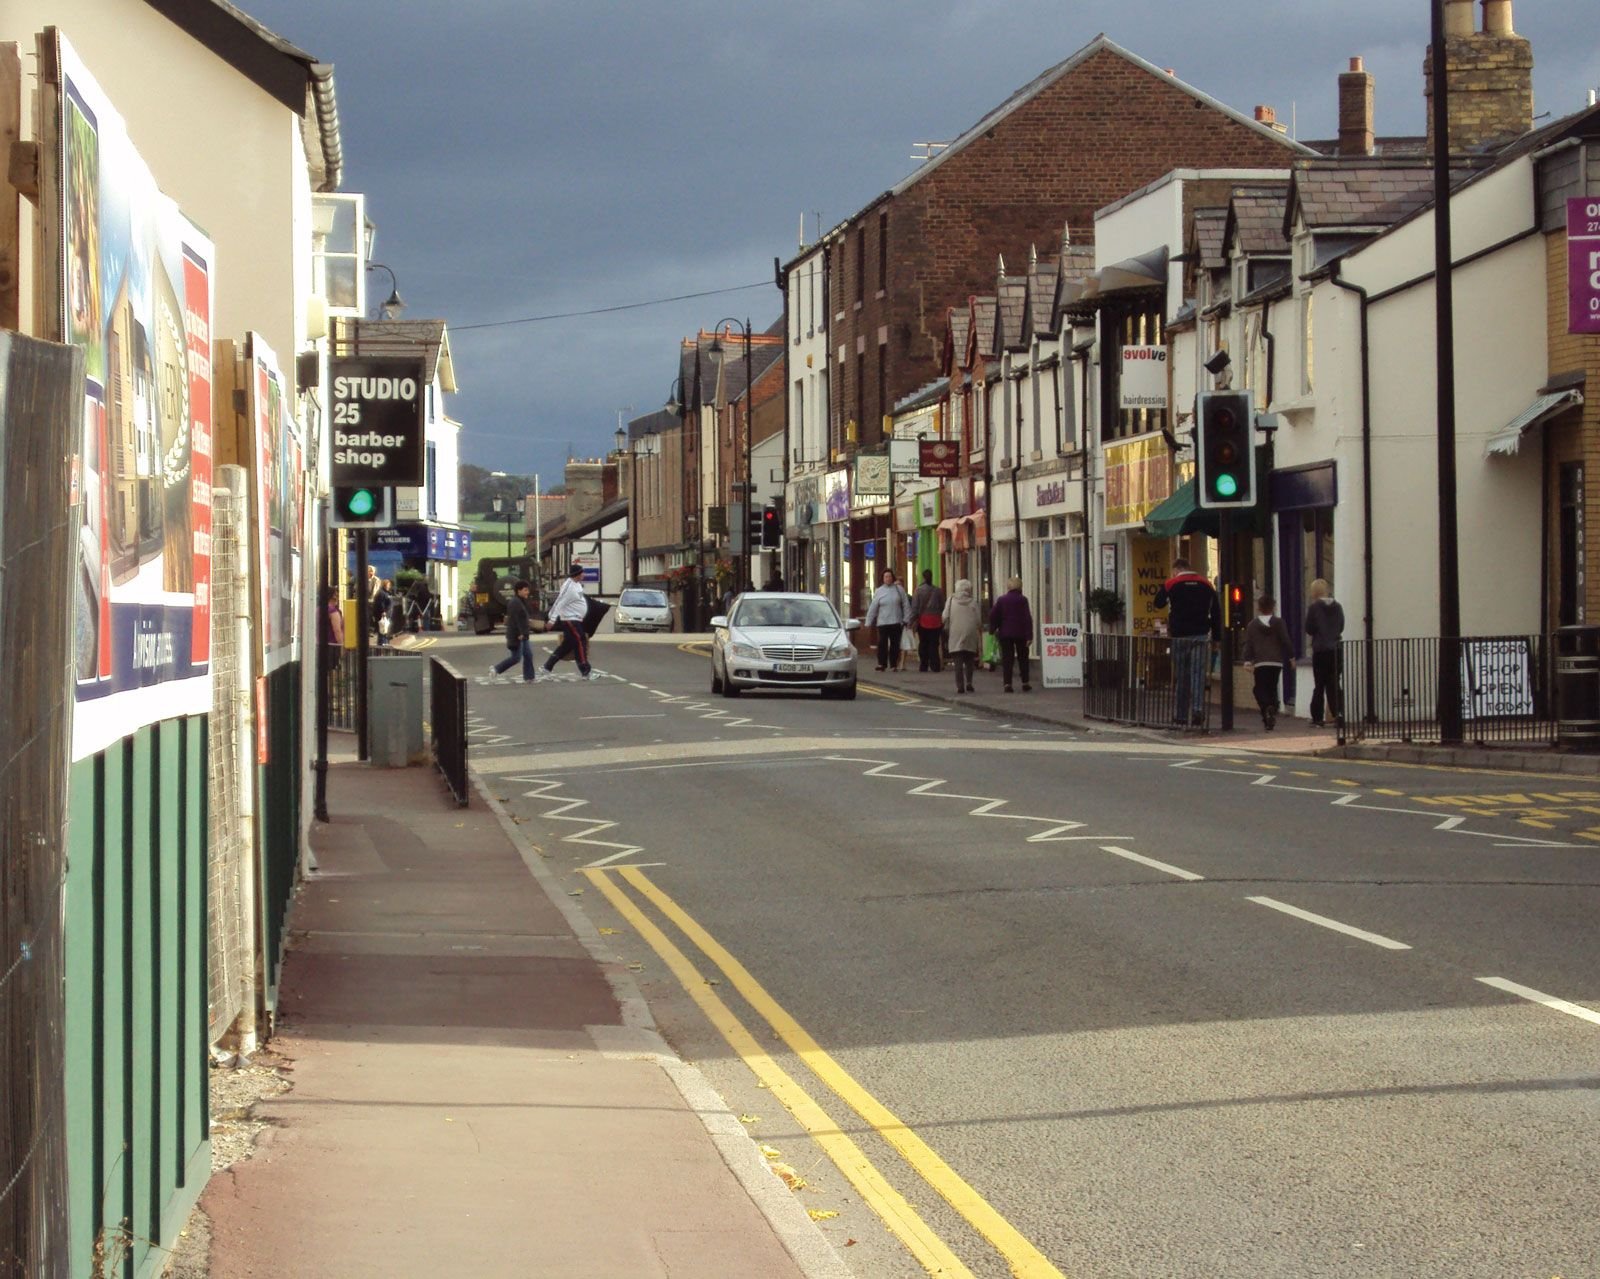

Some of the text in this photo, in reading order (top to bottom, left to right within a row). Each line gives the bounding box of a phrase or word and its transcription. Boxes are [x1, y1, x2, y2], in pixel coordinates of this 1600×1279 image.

[1124, 347, 1166, 361] evolve
[333, 376, 416, 400] STUDIO
[1123, 395, 1166, 406] hairdressing
[333, 403, 361, 424] 25
[334, 431, 405, 447] barber
[334, 449, 386, 468] shop
[1576, 468, 1584, 620] RECORDS
[1143, 551, 1160, 563] WE
[1137, 567, 1167, 580] WILL
[1133, 617, 1169, 629] BEA
[1044, 625, 1078, 637] evolve
[1046, 644, 1077, 657] £350
[1473, 644, 1527, 656] RECORD
[1479, 664, 1521, 677] SHOP
[1479, 683, 1522, 696] OPEN
[1485, 701, 1532, 713] TODAY
